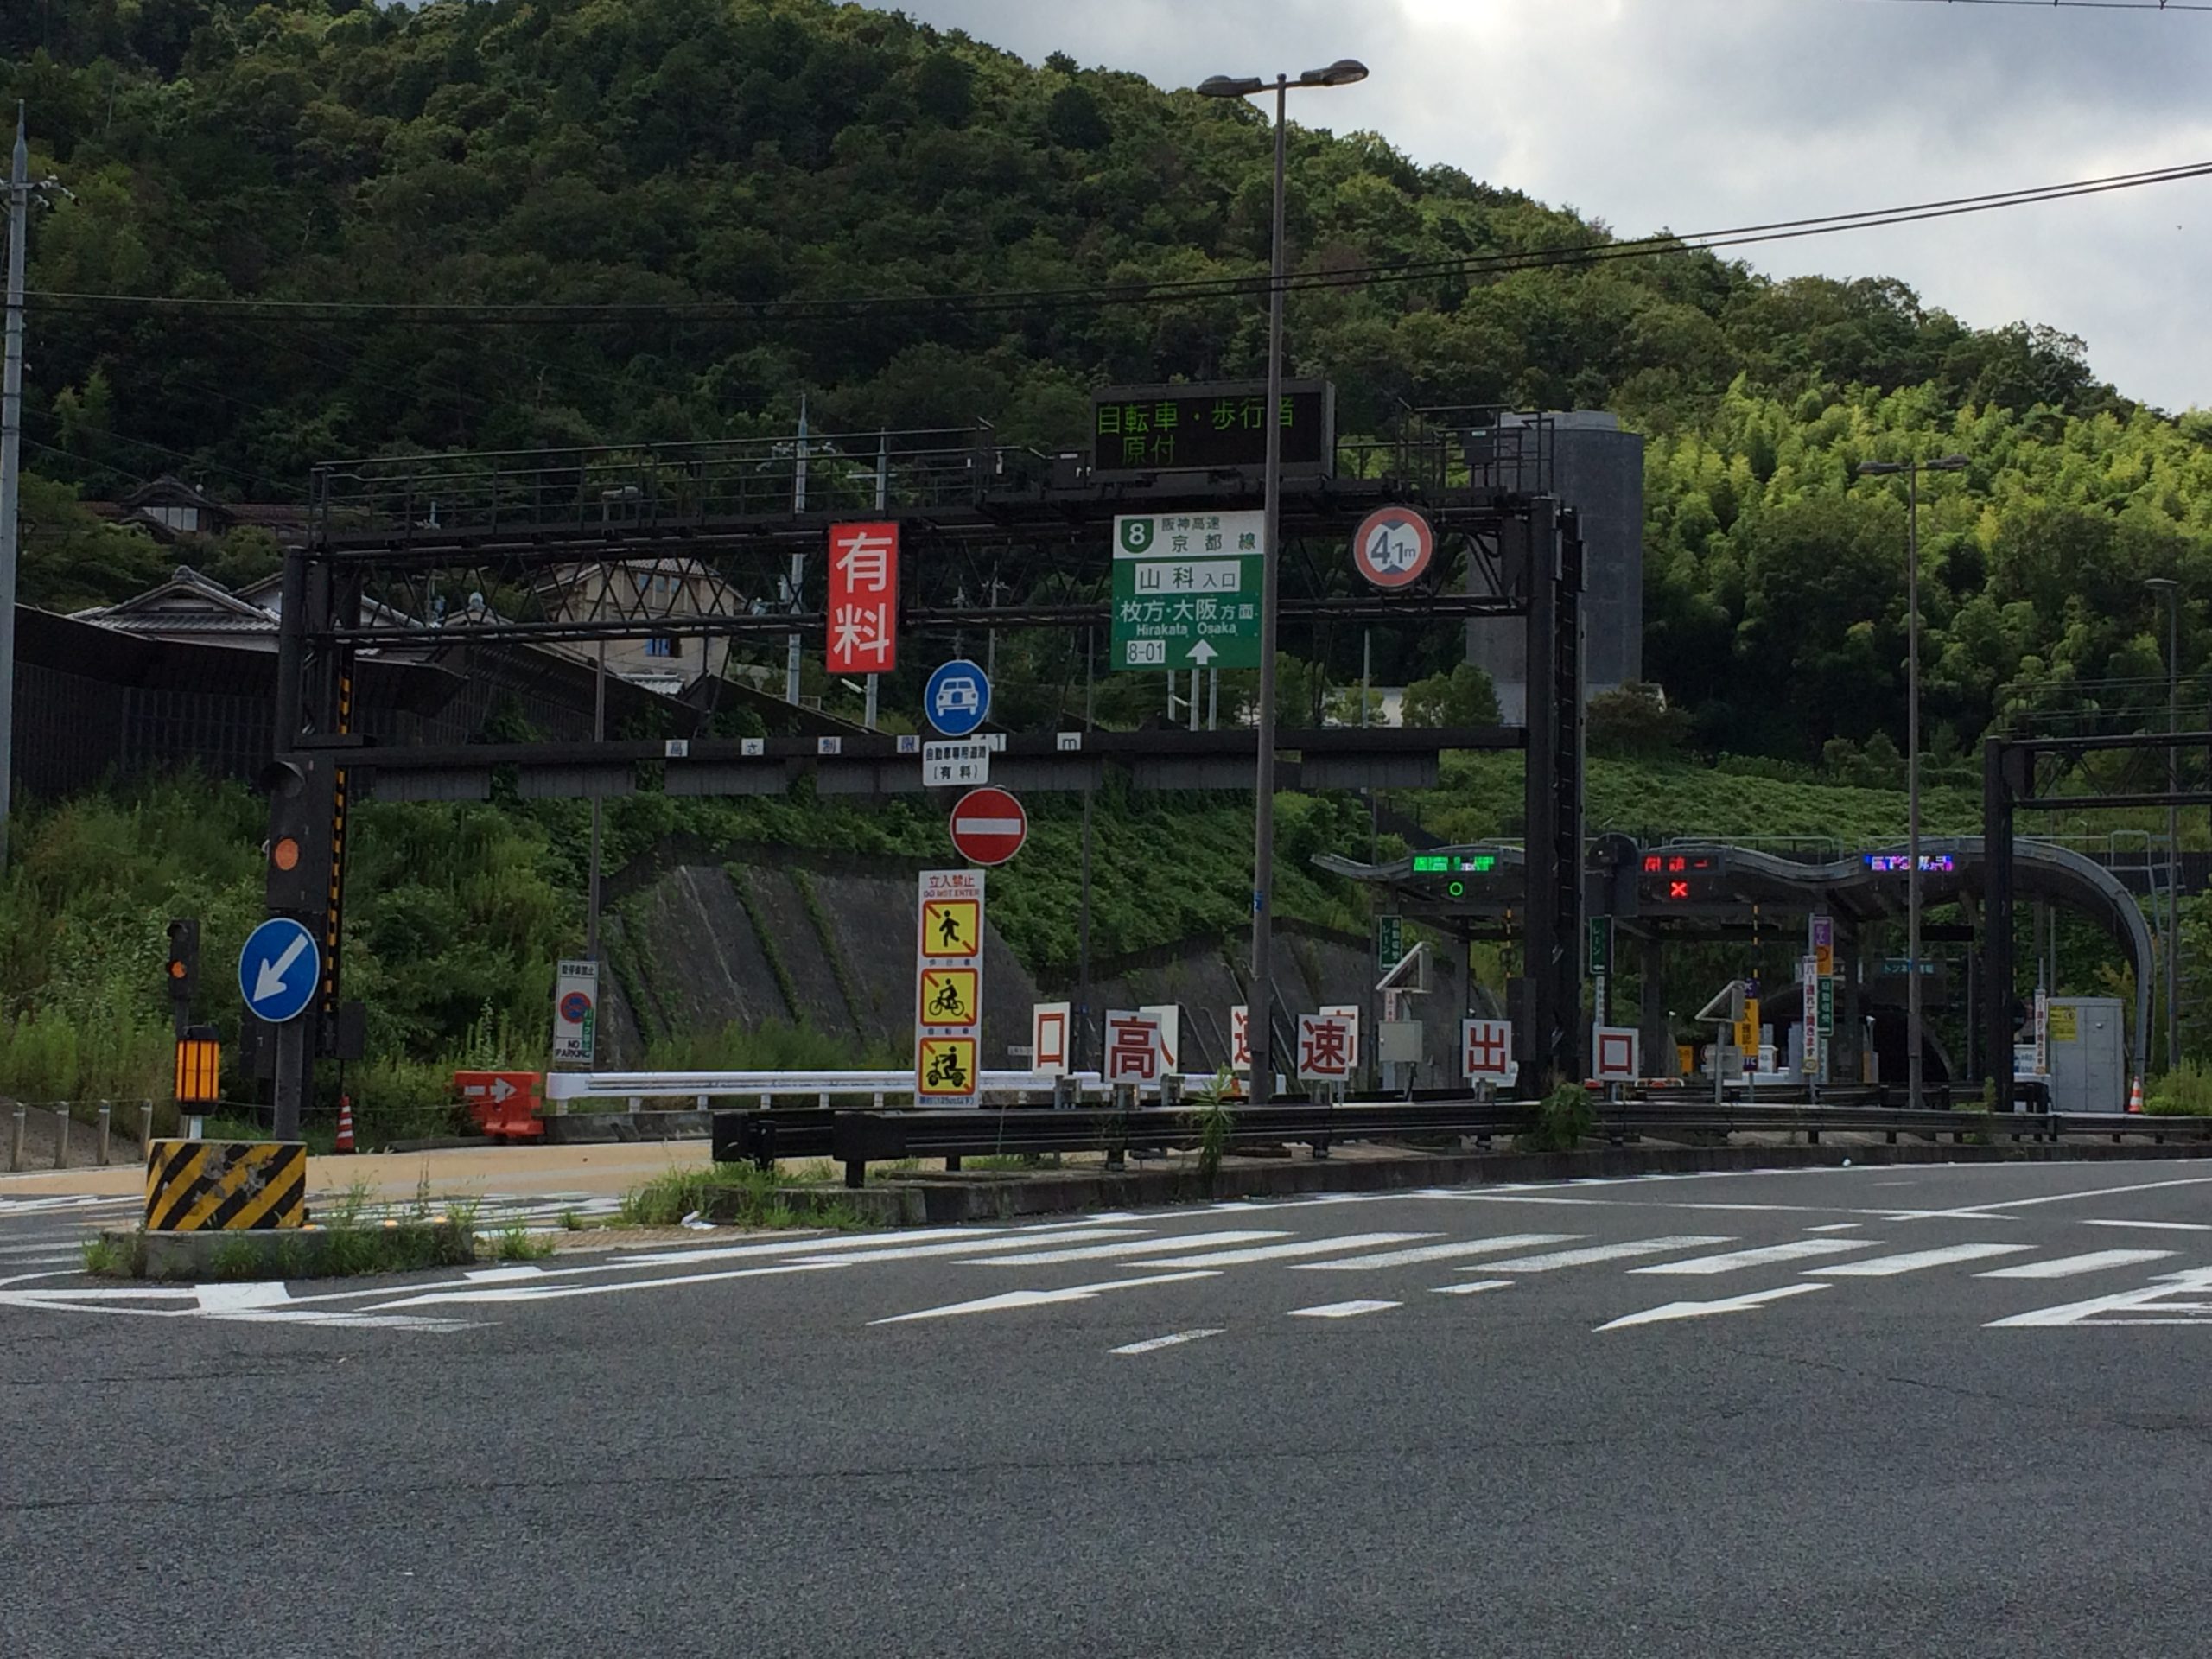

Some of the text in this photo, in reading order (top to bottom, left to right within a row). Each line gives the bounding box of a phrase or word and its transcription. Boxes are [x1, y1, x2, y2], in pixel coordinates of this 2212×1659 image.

[1122, 435, 1176, 465] 原付
[1161, 517, 1220, 532] 阪神高速
[1128, 523, 1146, 545] 8
[1171, 533, 1255, 552] 京都線
[833, 531, 893, 664] 有料
[1136, 622, 1236, 636] Hirakata Osaka
[1128, 642, 1164, 661] 8-01
[1062, 737, 1077, 751] m
[929, 874, 975, 888] 立入禁止
[555, 1048, 591, 1058] PARKING
[567, 1040, 581, 1049] NO
[1110, 1016, 1158, 1079] 高
[1301, 1020, 1345, 1074] 速
[1468, 1024, 1506, 1074] 出
